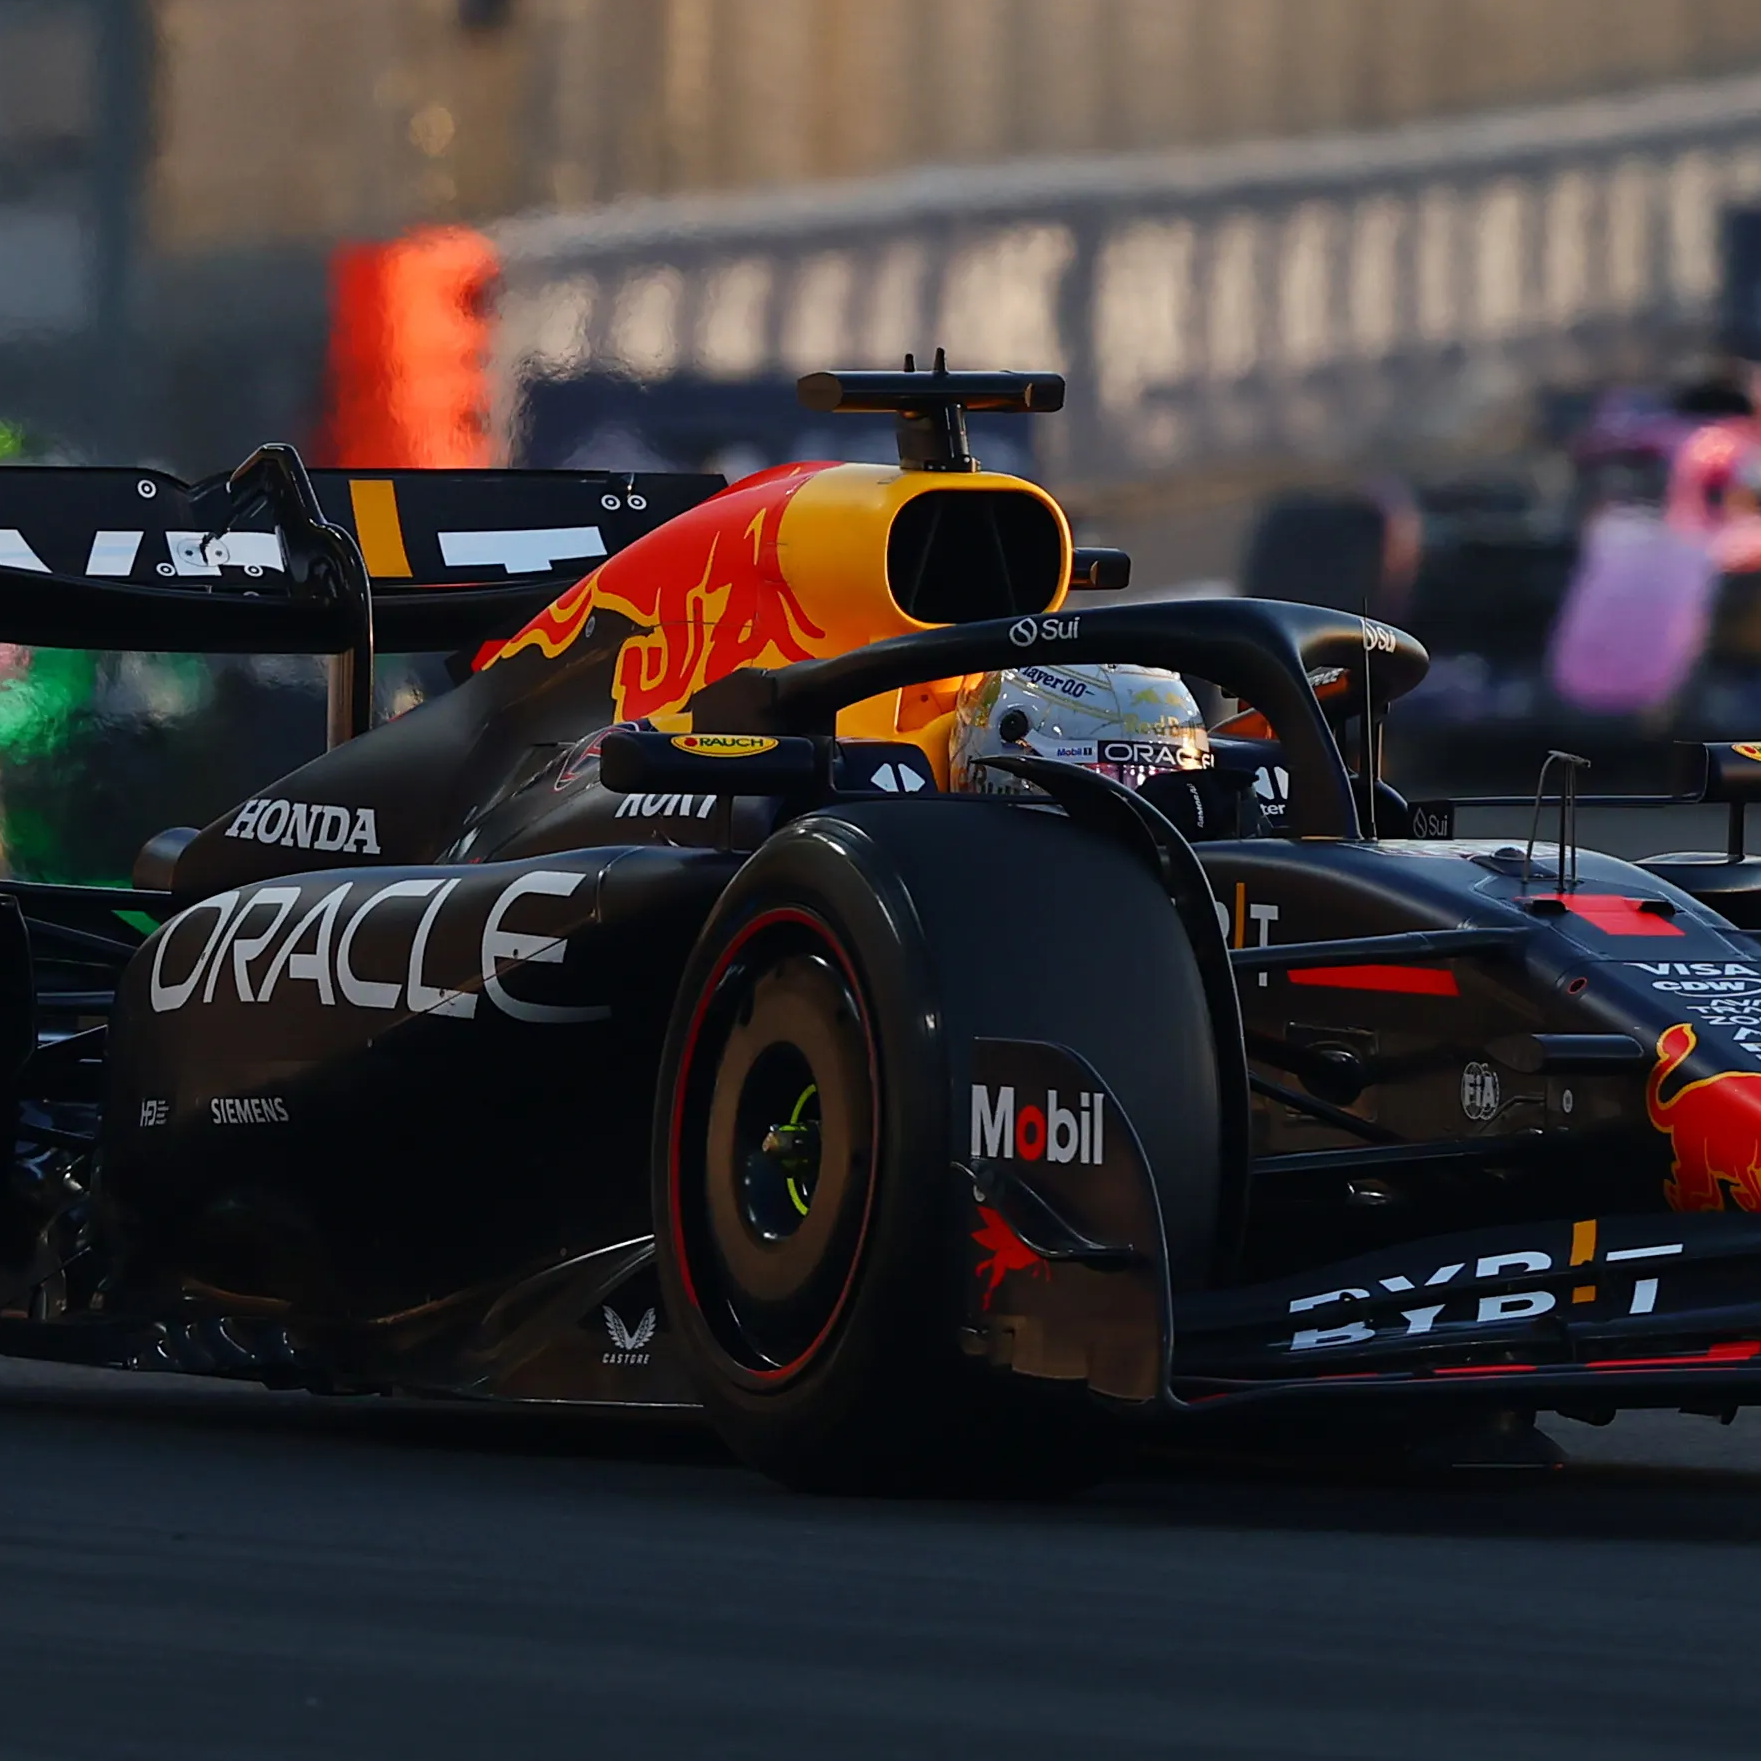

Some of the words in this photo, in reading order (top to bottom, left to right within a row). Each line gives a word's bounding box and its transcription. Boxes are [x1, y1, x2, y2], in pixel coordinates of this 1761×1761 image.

[1041, 616, 1081, 641] Sui
[699, 737, 764, 748] RAUCH
[1056, 746, 1083, 757] Mobil
[225, 798, 381, 855] HONDA
[1428, 814, 1448, 837] Sui
[150, 870, 613, 1024] ORACLE
[1623, 962, 1761, 976] VISA
[1651, 980, 1746, 991] CDW
[1463, 1072, 1496, 1109] FIA
[210, 1097, 289, 1125] SIEMENS
[971, 1084, 1105, 1165] Mobil
[602, 1353, 651, 1365] CASTORE
